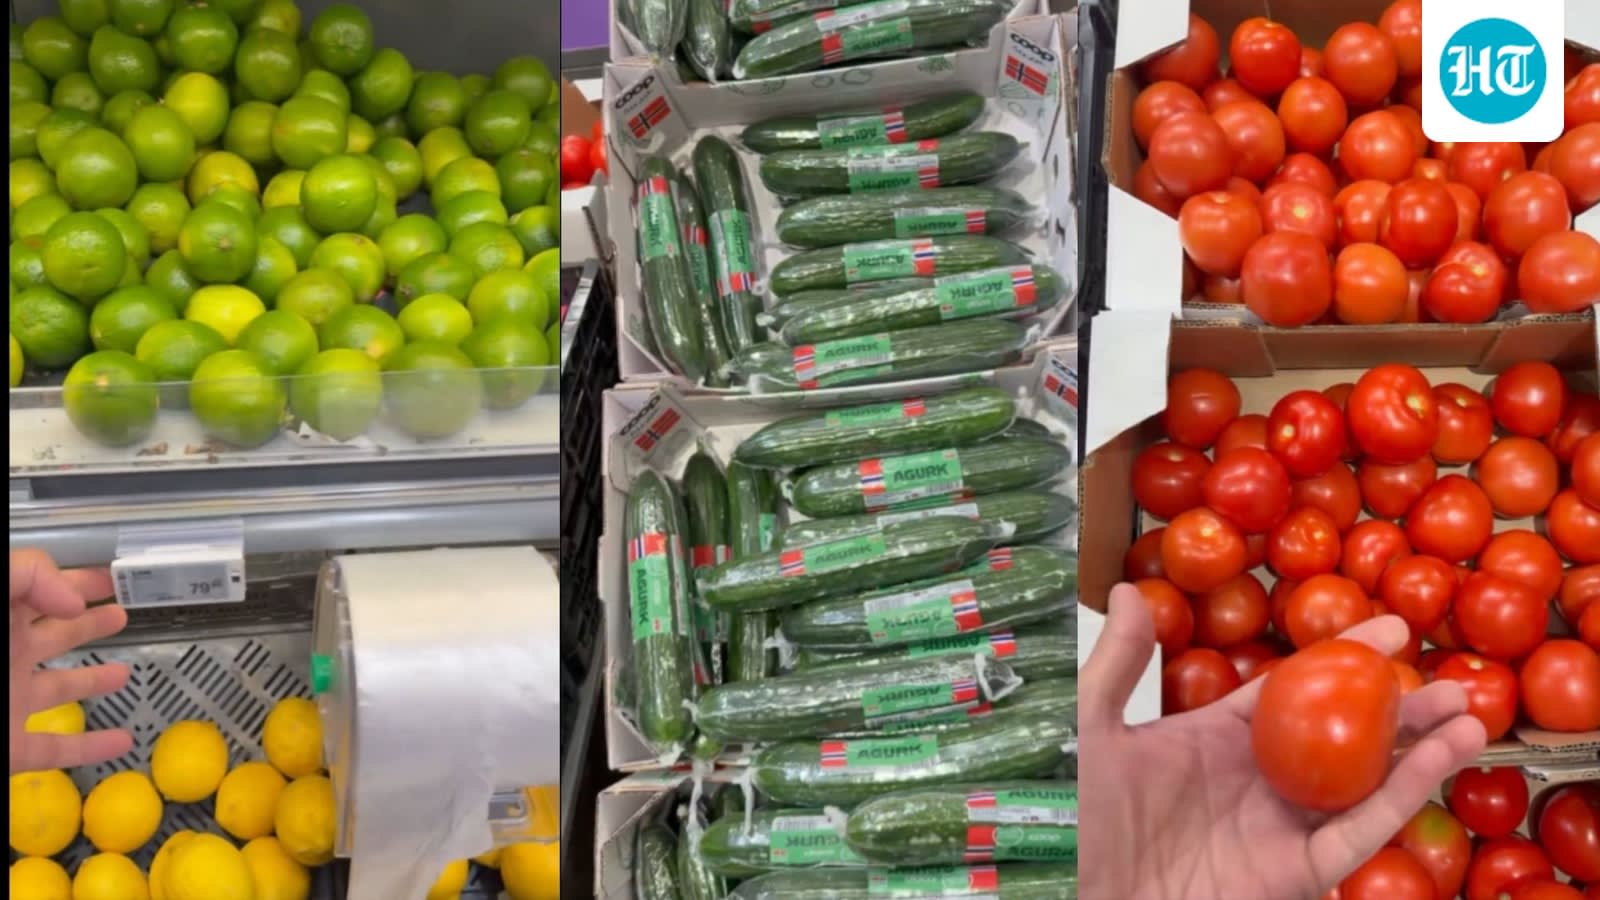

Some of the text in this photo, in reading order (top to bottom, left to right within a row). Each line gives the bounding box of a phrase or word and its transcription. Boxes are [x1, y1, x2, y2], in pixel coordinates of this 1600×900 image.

[1010, 33, 1054, 62] coop
[614, 76, 654, 109] coop
[908, 221, 957, 232] AGURK
[950, 281, 1003, 299] AGURK
[824, 342, 879, 358] AGURK
[620, 395, 661, 436] coop
[893, 464, 948, 482] AGURK
[815, 545, 872, 563] AGURK
[190, 582, 210, 594] 79
[637, 569, 649, 625] AGURK
[922, 636, 981, 652] AGURK
[877, 686, 942, 702] AGURK
[857, 745, 922, 759] AGURK
